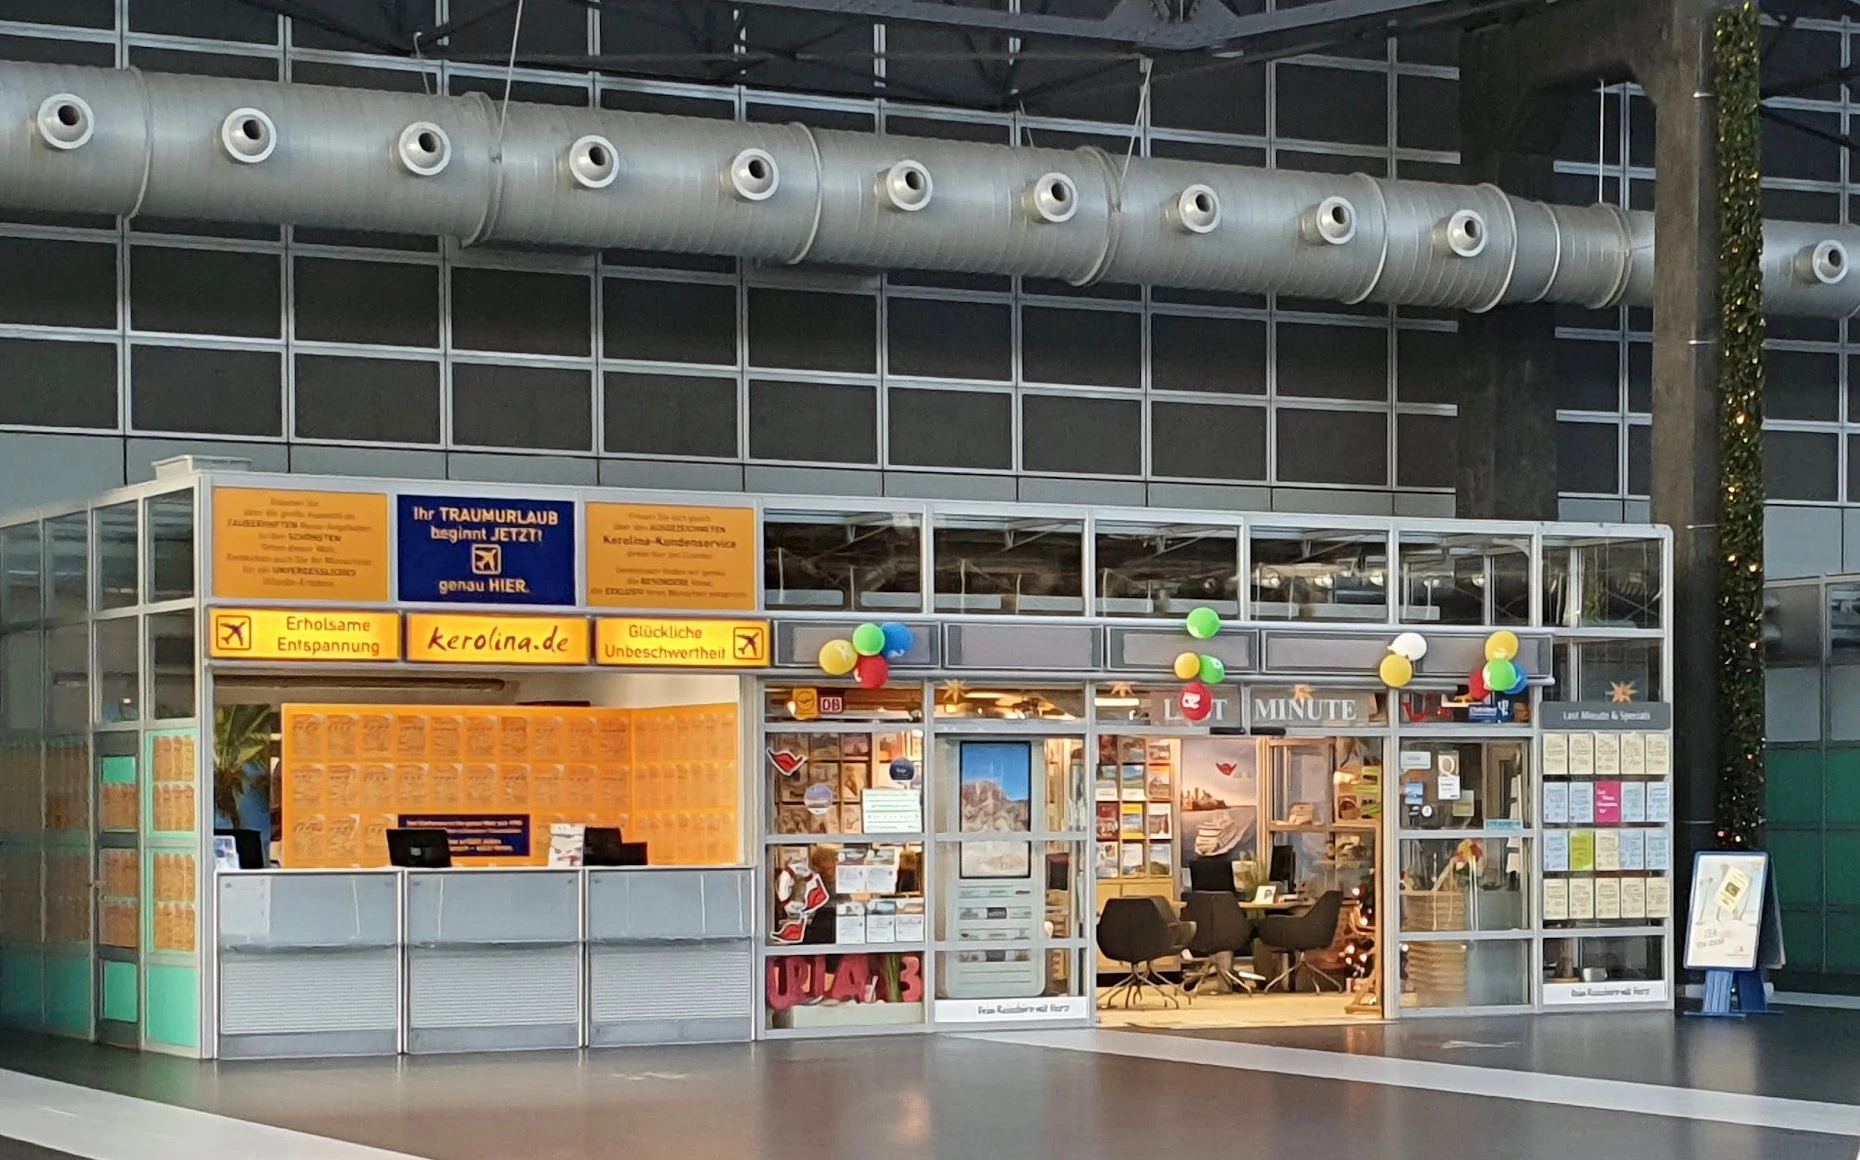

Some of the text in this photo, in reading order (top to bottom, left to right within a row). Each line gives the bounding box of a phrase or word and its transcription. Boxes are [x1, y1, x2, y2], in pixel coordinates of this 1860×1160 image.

[413, 506, 559, 525] Ihr TRAUMURLAUB
[430, 525, 543, 543] beginnt JETZT!
[439, 580, 484, 594] genau
[286, 615, 371, 632] Erholsame
[629, 624, 702, 640] Glückliche
[277, 636, 380, 655] Entspannung
[427, 625, 569, 652] kerolina.de
[604, 644, 726, 661] Unbeschwertheit
[1164, 699, 1228, 721] LT
[1255, 699, 1357, 721] MINUTE
[1563, 711, 1579, 720] Last
[1581, 711, 1610, 720] Minute
[1611, 711, 1618, 720] &
